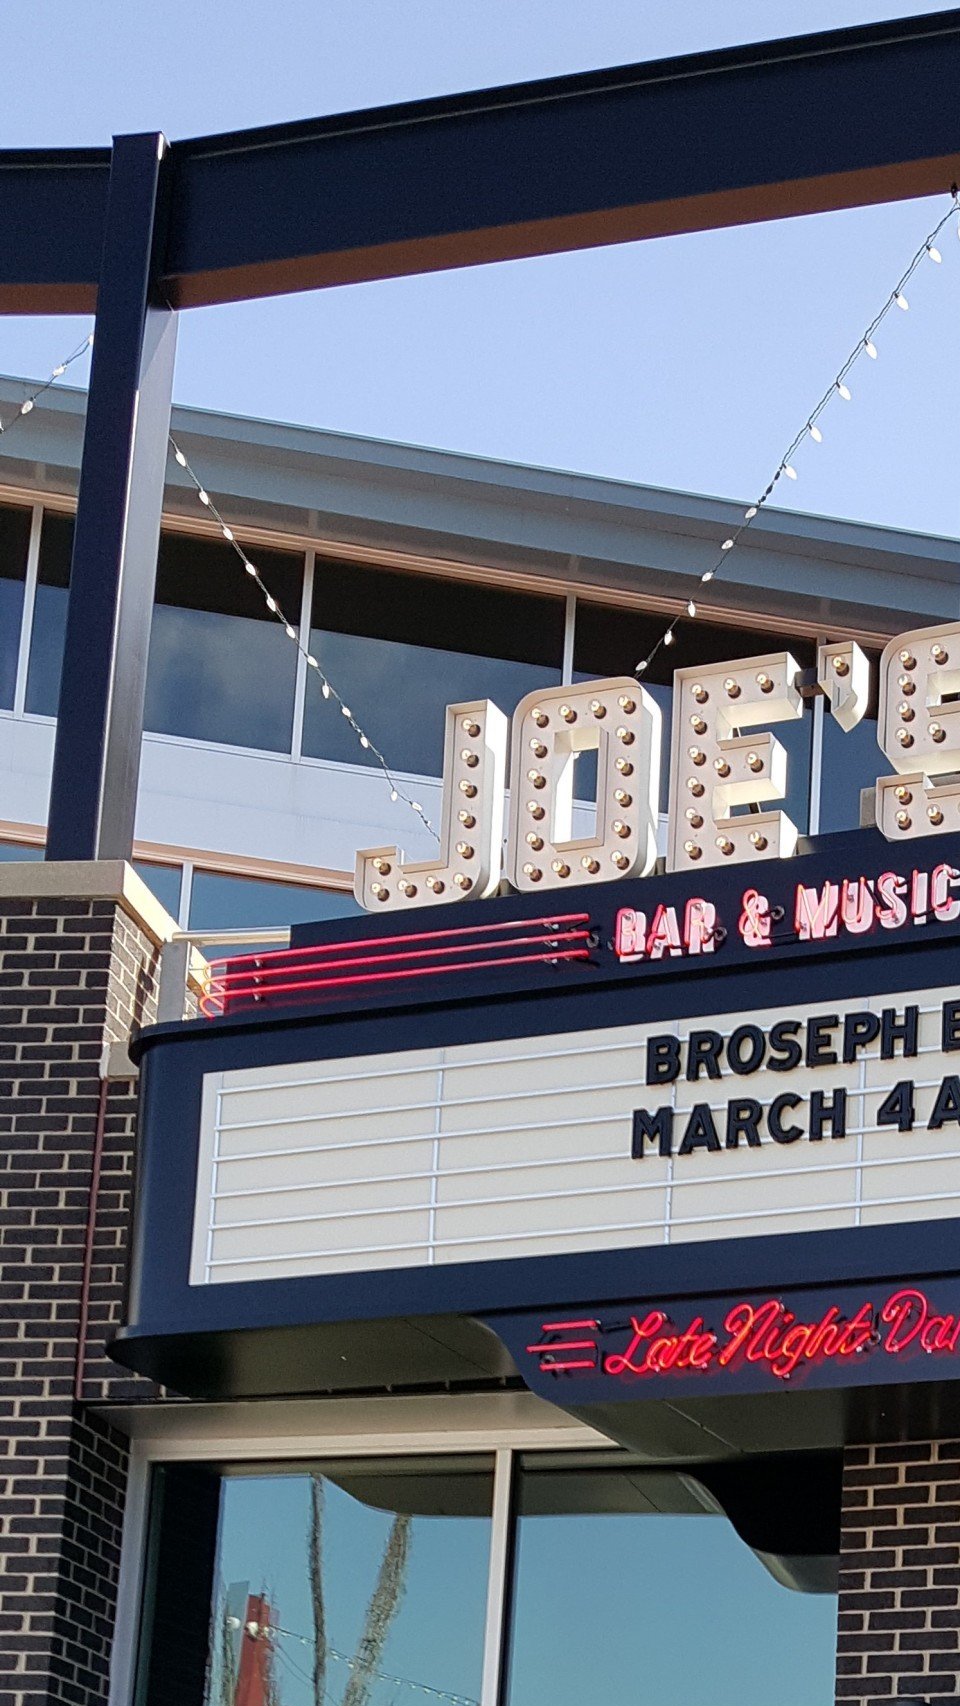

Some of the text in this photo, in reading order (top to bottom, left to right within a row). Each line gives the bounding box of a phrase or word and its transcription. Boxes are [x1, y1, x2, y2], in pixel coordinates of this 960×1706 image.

[615, 897, 717, 963] BAR
[738, 889, 772, 947] &
[645, 1005, 919, 1086] BROSEPH
[631, 1087, 848, 1160] MARCH
[876, 1080, 917, 1132] 4
[604, 1310, 717, 1374] Late
[717, 1299, 872, 1378] Night
